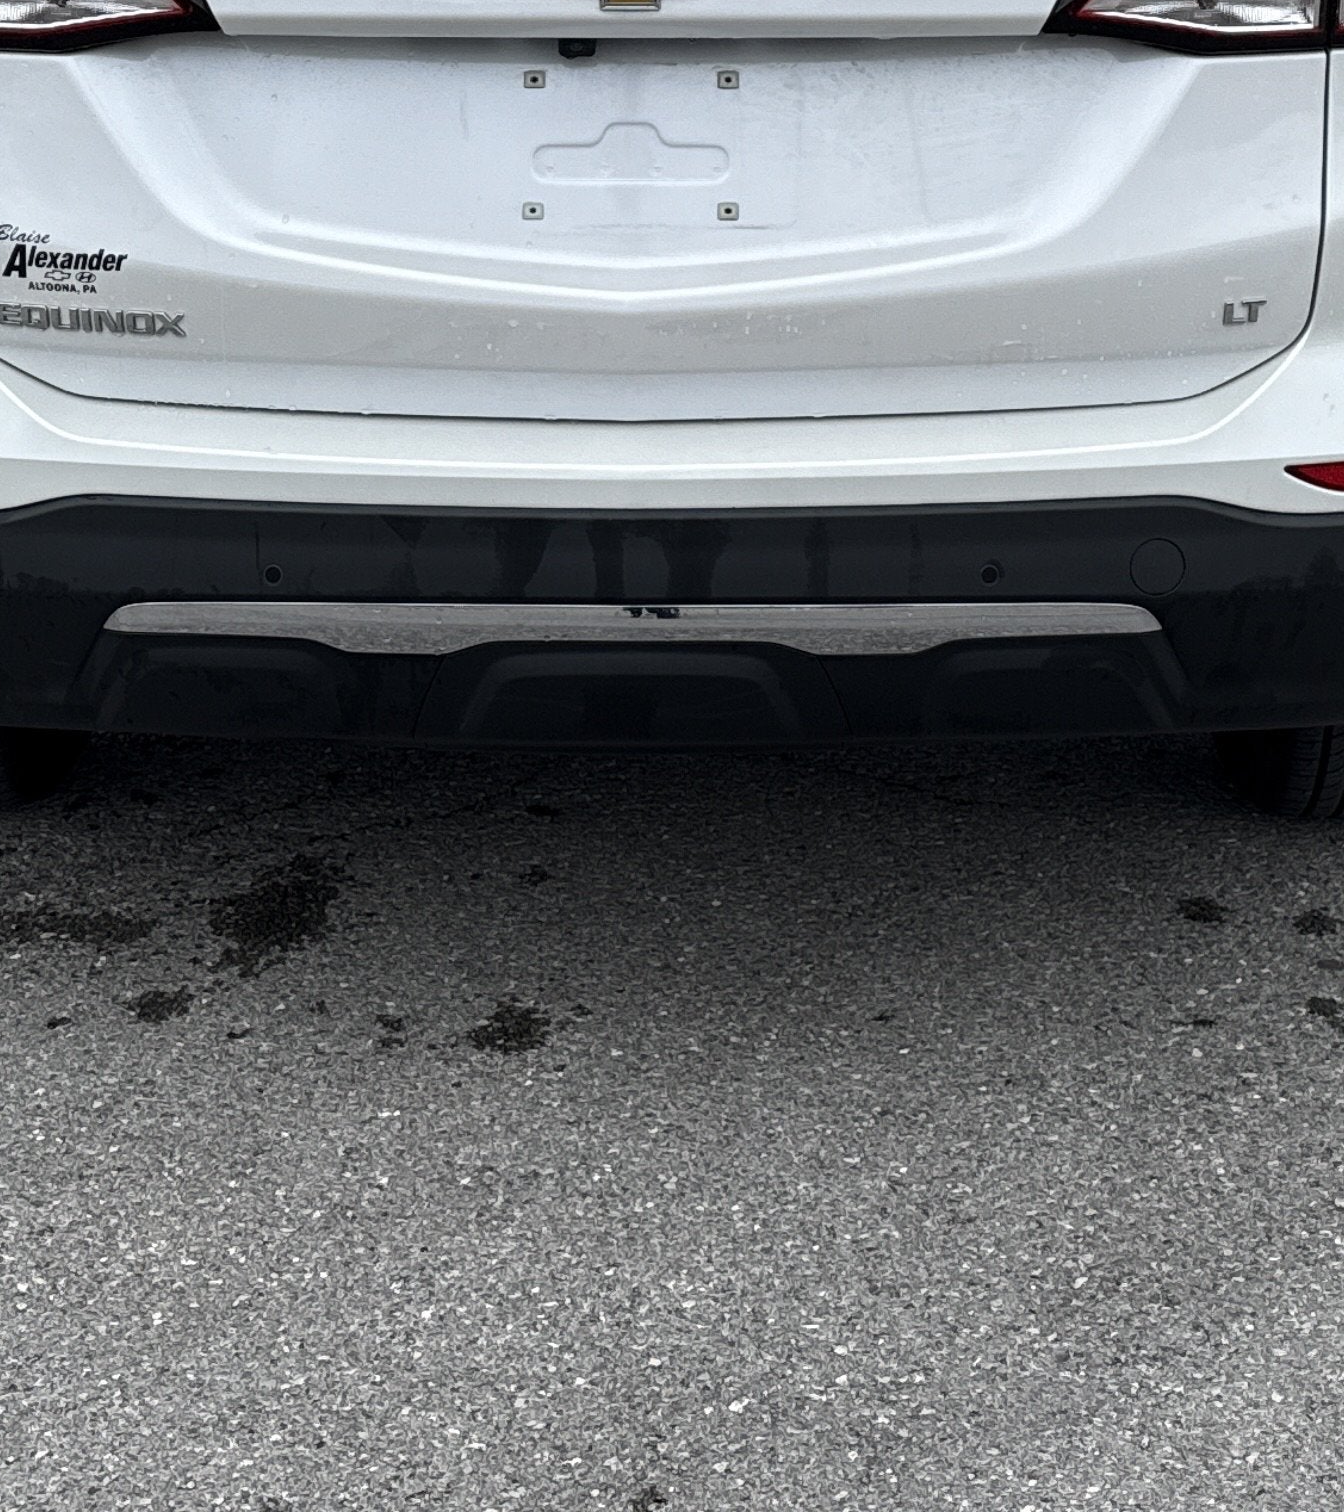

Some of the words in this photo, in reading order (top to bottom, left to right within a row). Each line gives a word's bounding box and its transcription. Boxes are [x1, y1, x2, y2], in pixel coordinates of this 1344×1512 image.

[2, 243, 128, 278] Alexander
[28, 281, 80, 295] ALTOONA,
[83, 284, 98, 294] PA
[1222, 296, 1267, 326] LT
